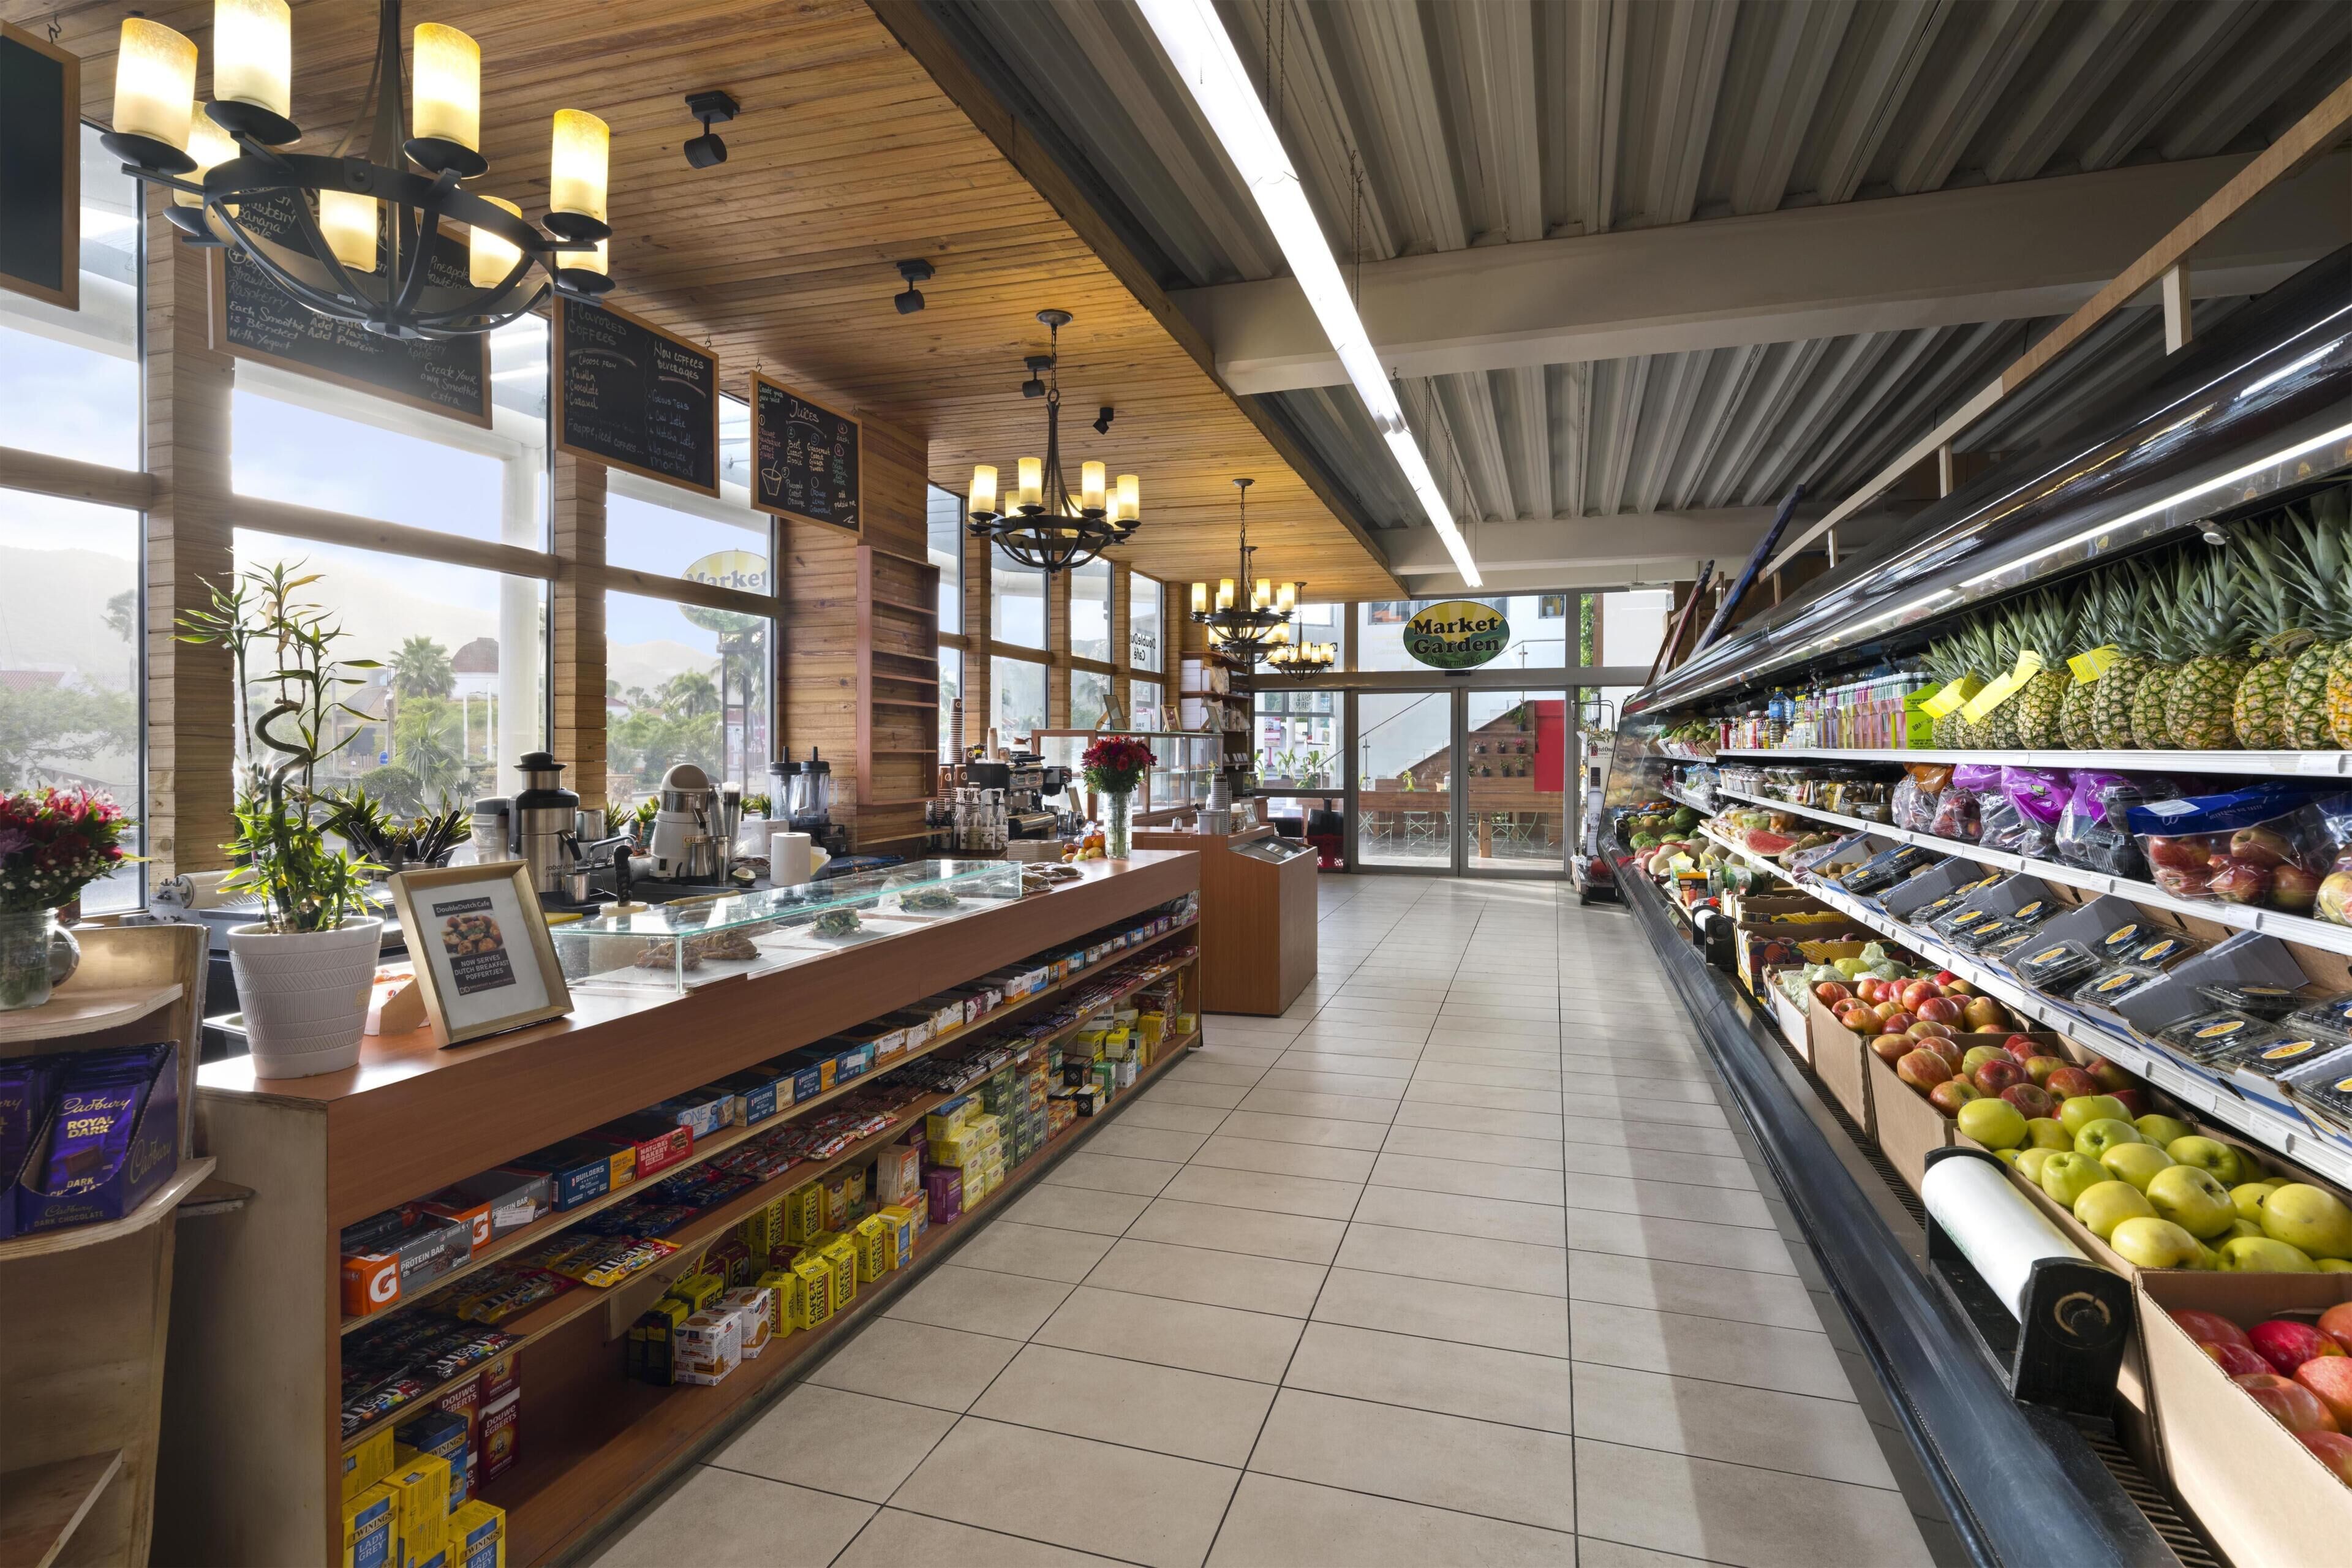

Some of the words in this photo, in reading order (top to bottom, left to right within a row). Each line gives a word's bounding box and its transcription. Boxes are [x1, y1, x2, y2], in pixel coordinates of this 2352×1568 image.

[310, 318, 333, 330] Add
[307, 328, 332, 340] Add
[1414, 617, 1498, 635] Market
[1414, 637, 1500, 654] Garden
[1429, 655, 1482, 667] Supermarket
[436, 902, 477, 913] DoubleDutch
[477, 954, 500, 963] SERVES
[454, 967, 475, 976] DUTCH
[475, 960, 509, 971] BREAKFAST
[466, 968, 503, 980] POFFERTJES
[58, 1097, 131, 1115] Cadbury
[67, 1116, 115, 1130] ROYAL
[682, 1106, 707, 1125] ONE
[67, 1125, 110, 1139] DARK
[129, 1136, 172, 1184] Cadbury
[641, 1145, 668, 1161] BAKERY
[576, 1165, 605, 1183] BUILDERS
[67, 1177, 94, 1189] DARK
[516, 1196, 528, 1208] BAR
[34, 1218, 55, 1227] DARK
[58, 1211, 104, 1223] CHOCOLATE
[45, 1204, 93, 1218] Cadbury
[401, 1251, 429, 1272] PROTEIN
[431, 1244, 445, 1257] BAR
[484, 1411, 516, 1437] EGBERTS
[432, 1436, 463, 1456] WININGS
[352, 1510, 393, 1541] TWININGS
[359, 1531, 384, 1553] LADY
[464, 1529, 500, 1558] TWININGS
[358, 1539, 383, 1562] GREY
[471, 1548, 492, 1568] LADY
